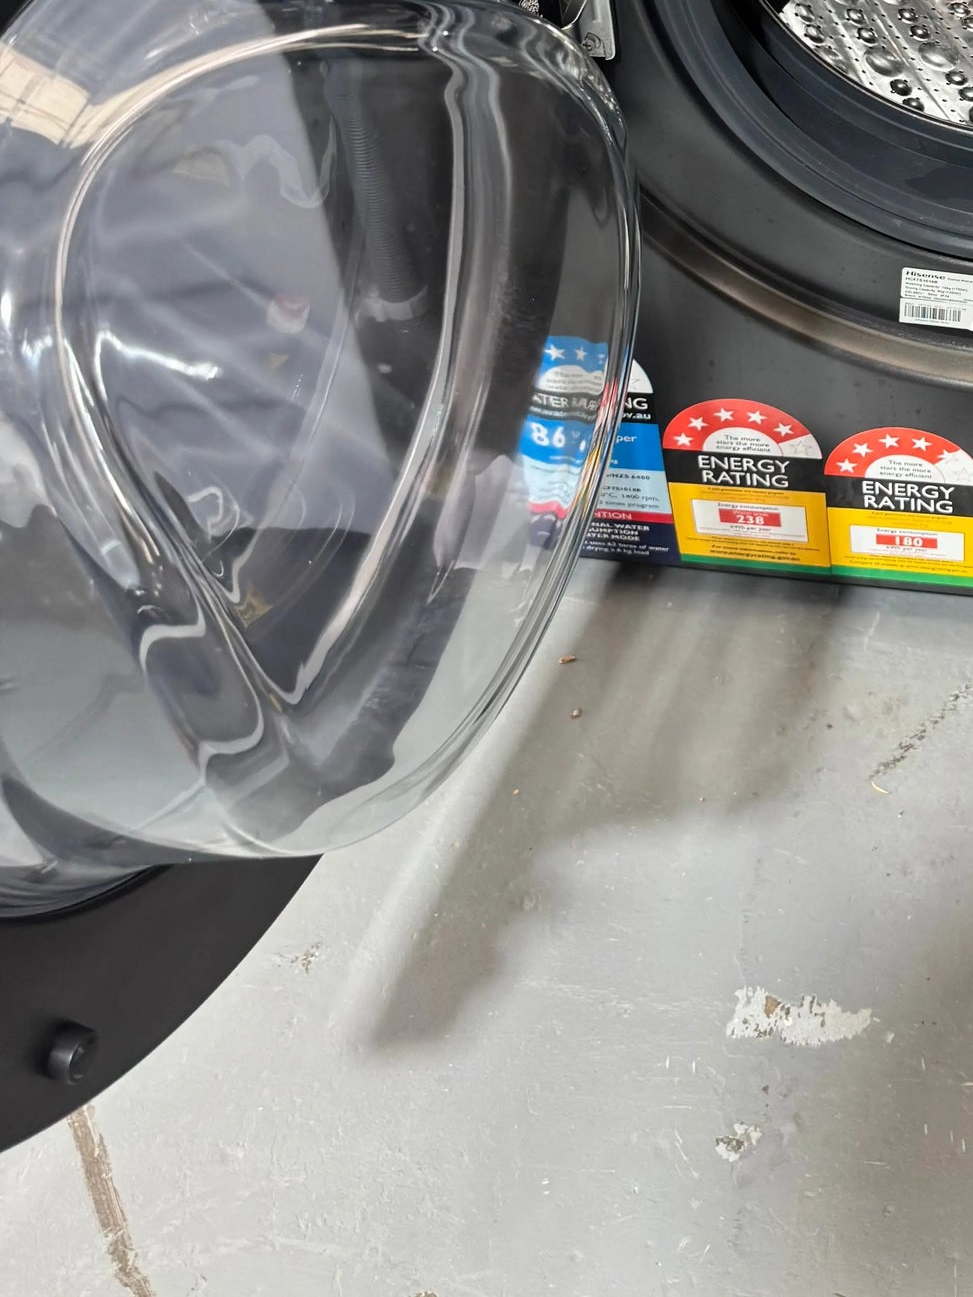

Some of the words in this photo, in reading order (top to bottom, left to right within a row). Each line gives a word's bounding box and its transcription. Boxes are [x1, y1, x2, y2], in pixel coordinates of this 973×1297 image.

[906, 270, 946, 280] Hisense
[615, 434, 637, 444] per
[697, 455, 790, 474] ENERGY
[702, 470, 789, 488] RATING
[862, 480, 955, 500] ENERGY
[863, 495, 954, 514] RATING
[736, 514, 765, 525] 238
[894, 536, 924, 547] 180
